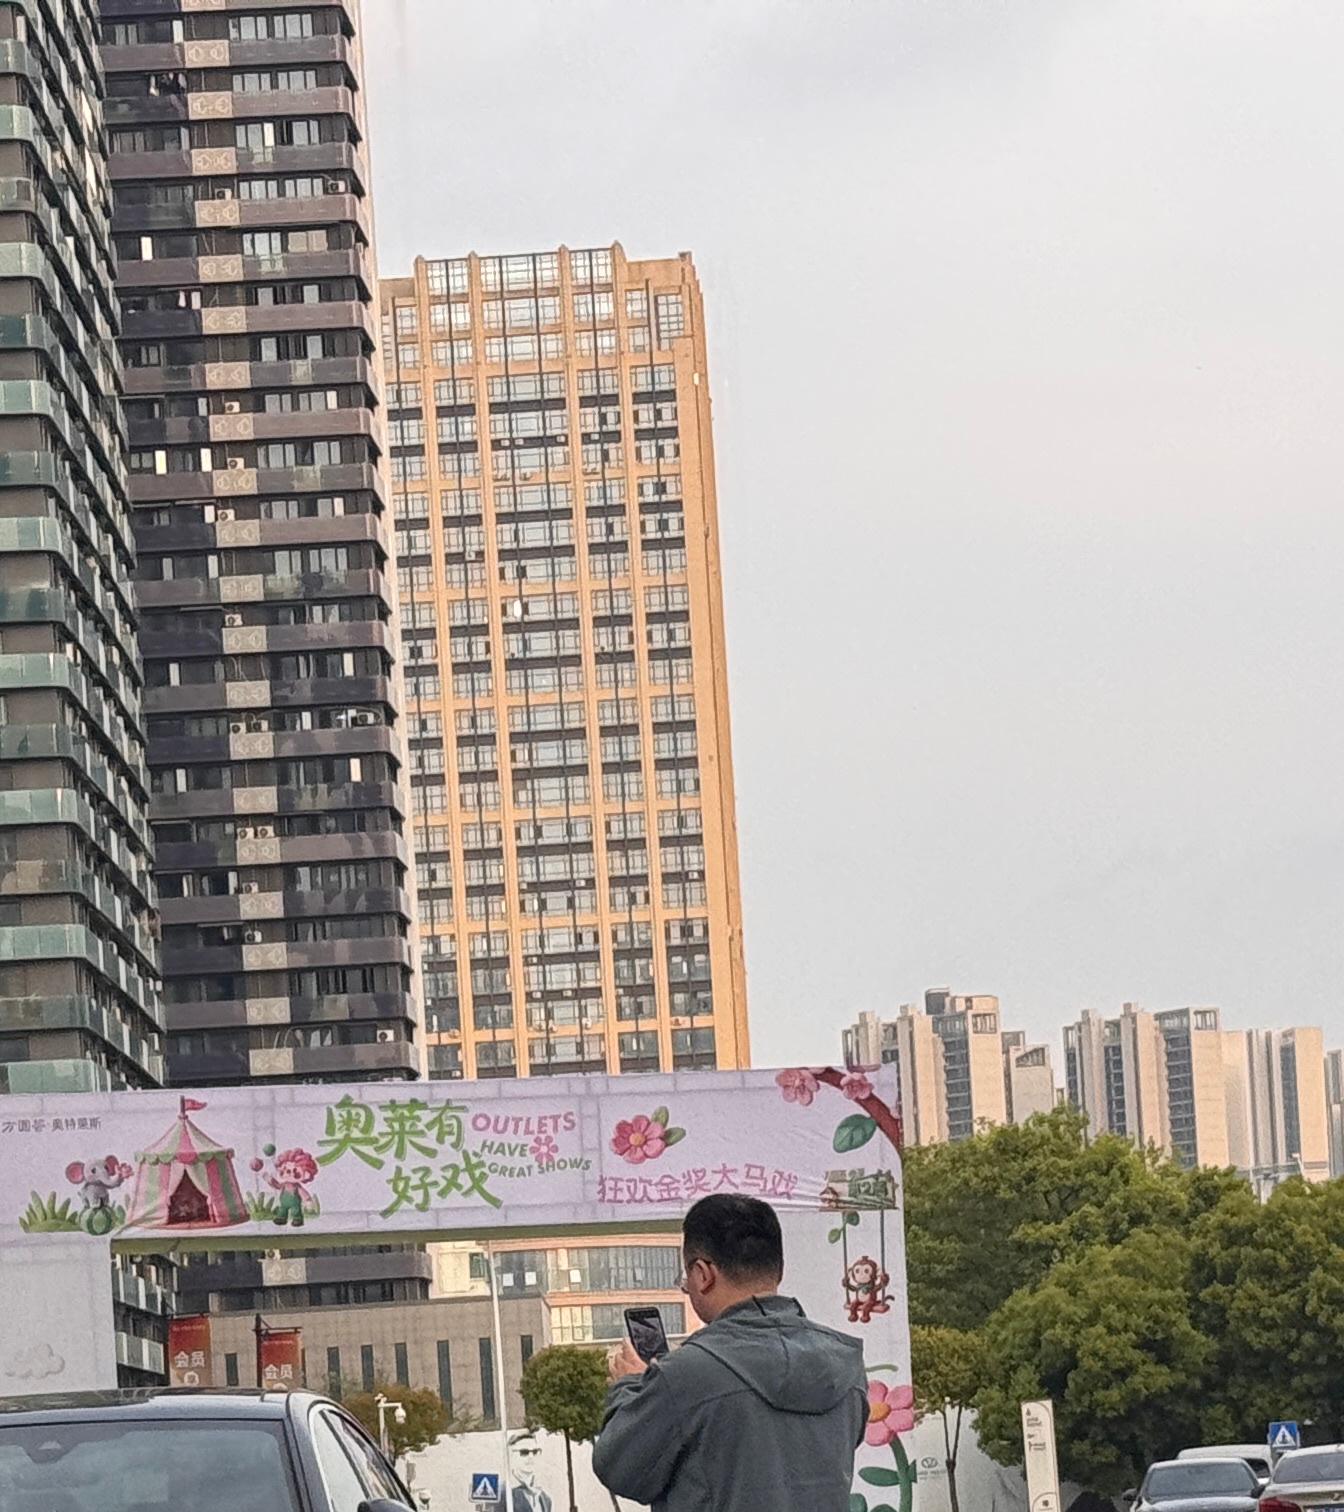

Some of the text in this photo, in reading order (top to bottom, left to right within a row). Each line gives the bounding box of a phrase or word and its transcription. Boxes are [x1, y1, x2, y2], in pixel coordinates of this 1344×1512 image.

[316, 1094, 468, 1170] 奥莱有
[471, 1111, 577, 1135] OUTLETS
[481, 1139, 529, 1158] HAVE
[488, 1156, 592, 1179] GREAT SHOWS
[379, 1149, 503, 1219] 好戏
[597, 1163, 798, 1205] 狂欢金奖大马戏
[174, 1350, 205, 1368] 会员
[264, 1363, 293, 1380] 会员
